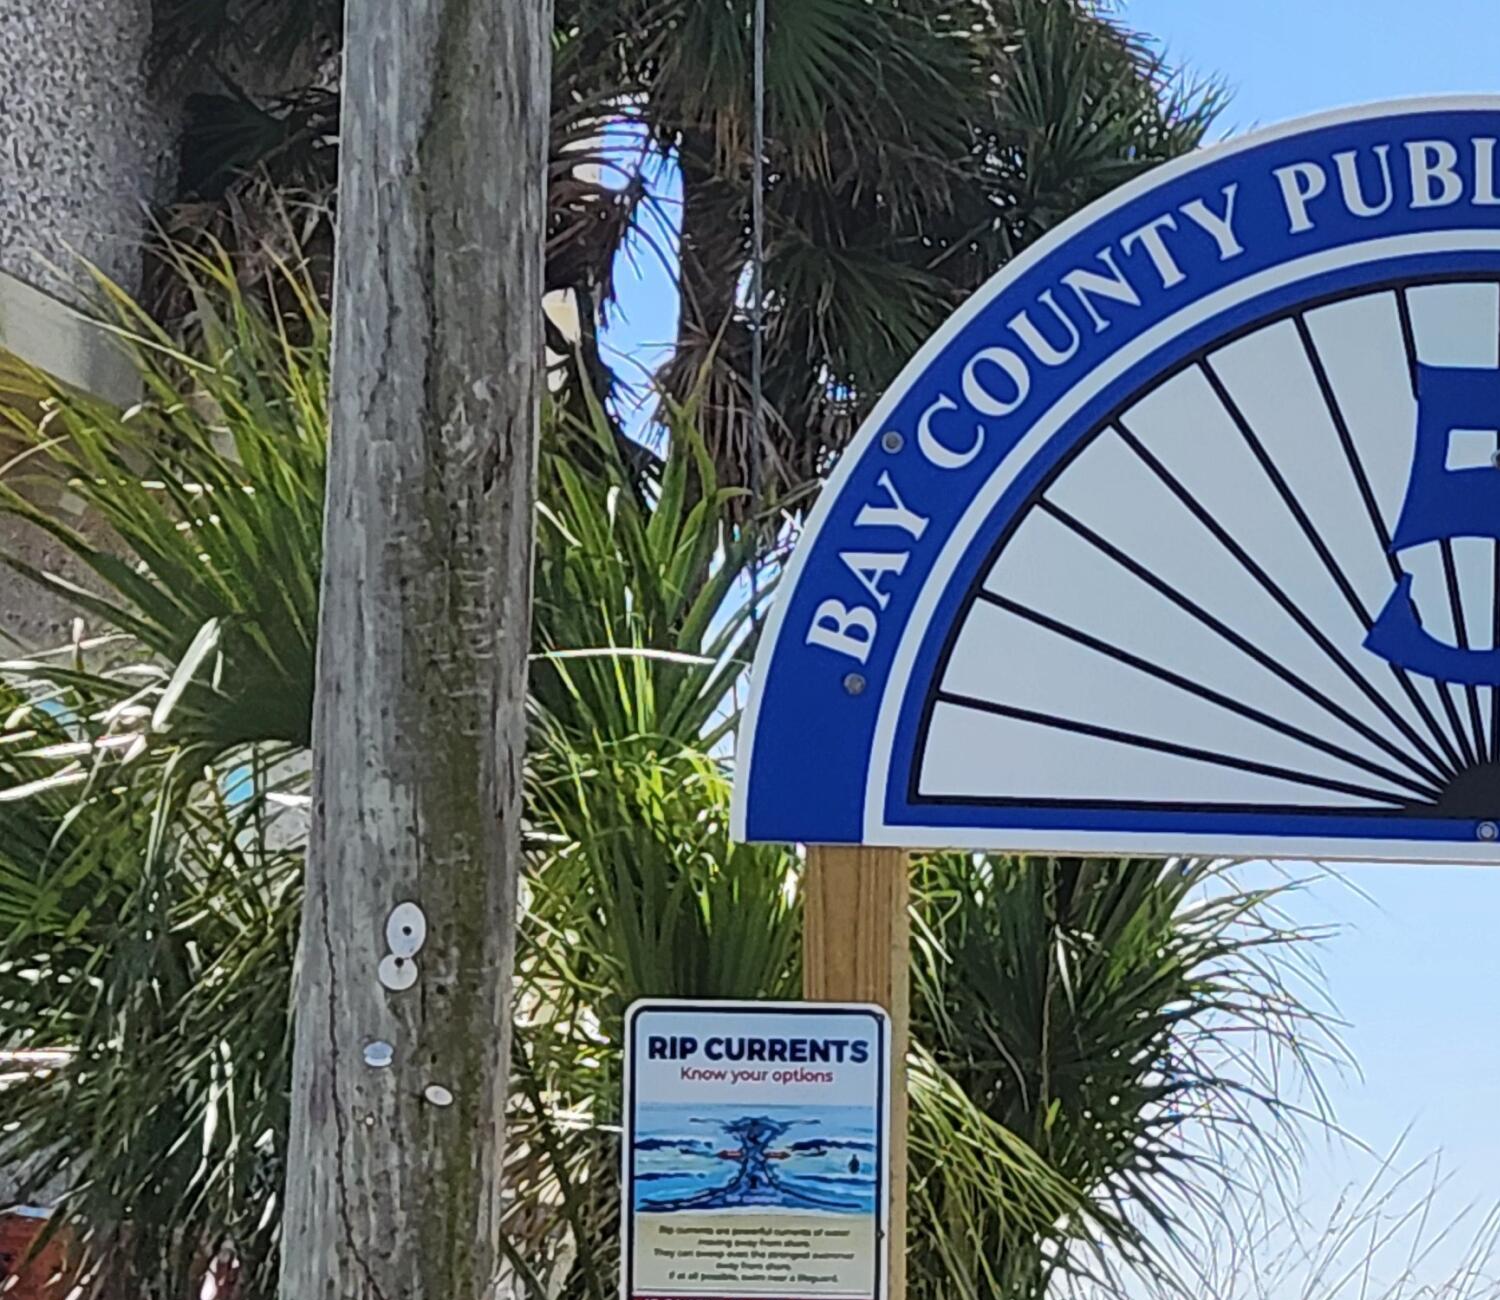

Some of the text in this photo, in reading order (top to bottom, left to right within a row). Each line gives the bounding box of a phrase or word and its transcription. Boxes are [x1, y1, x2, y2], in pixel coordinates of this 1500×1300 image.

[805, 470, 930, 665] BAY
[916, 182, 1244, 470] COUNTY
[648, 1036, 869, 1064] RIP CURRENTS
[680, 1066, 834, 1085] Know your options
